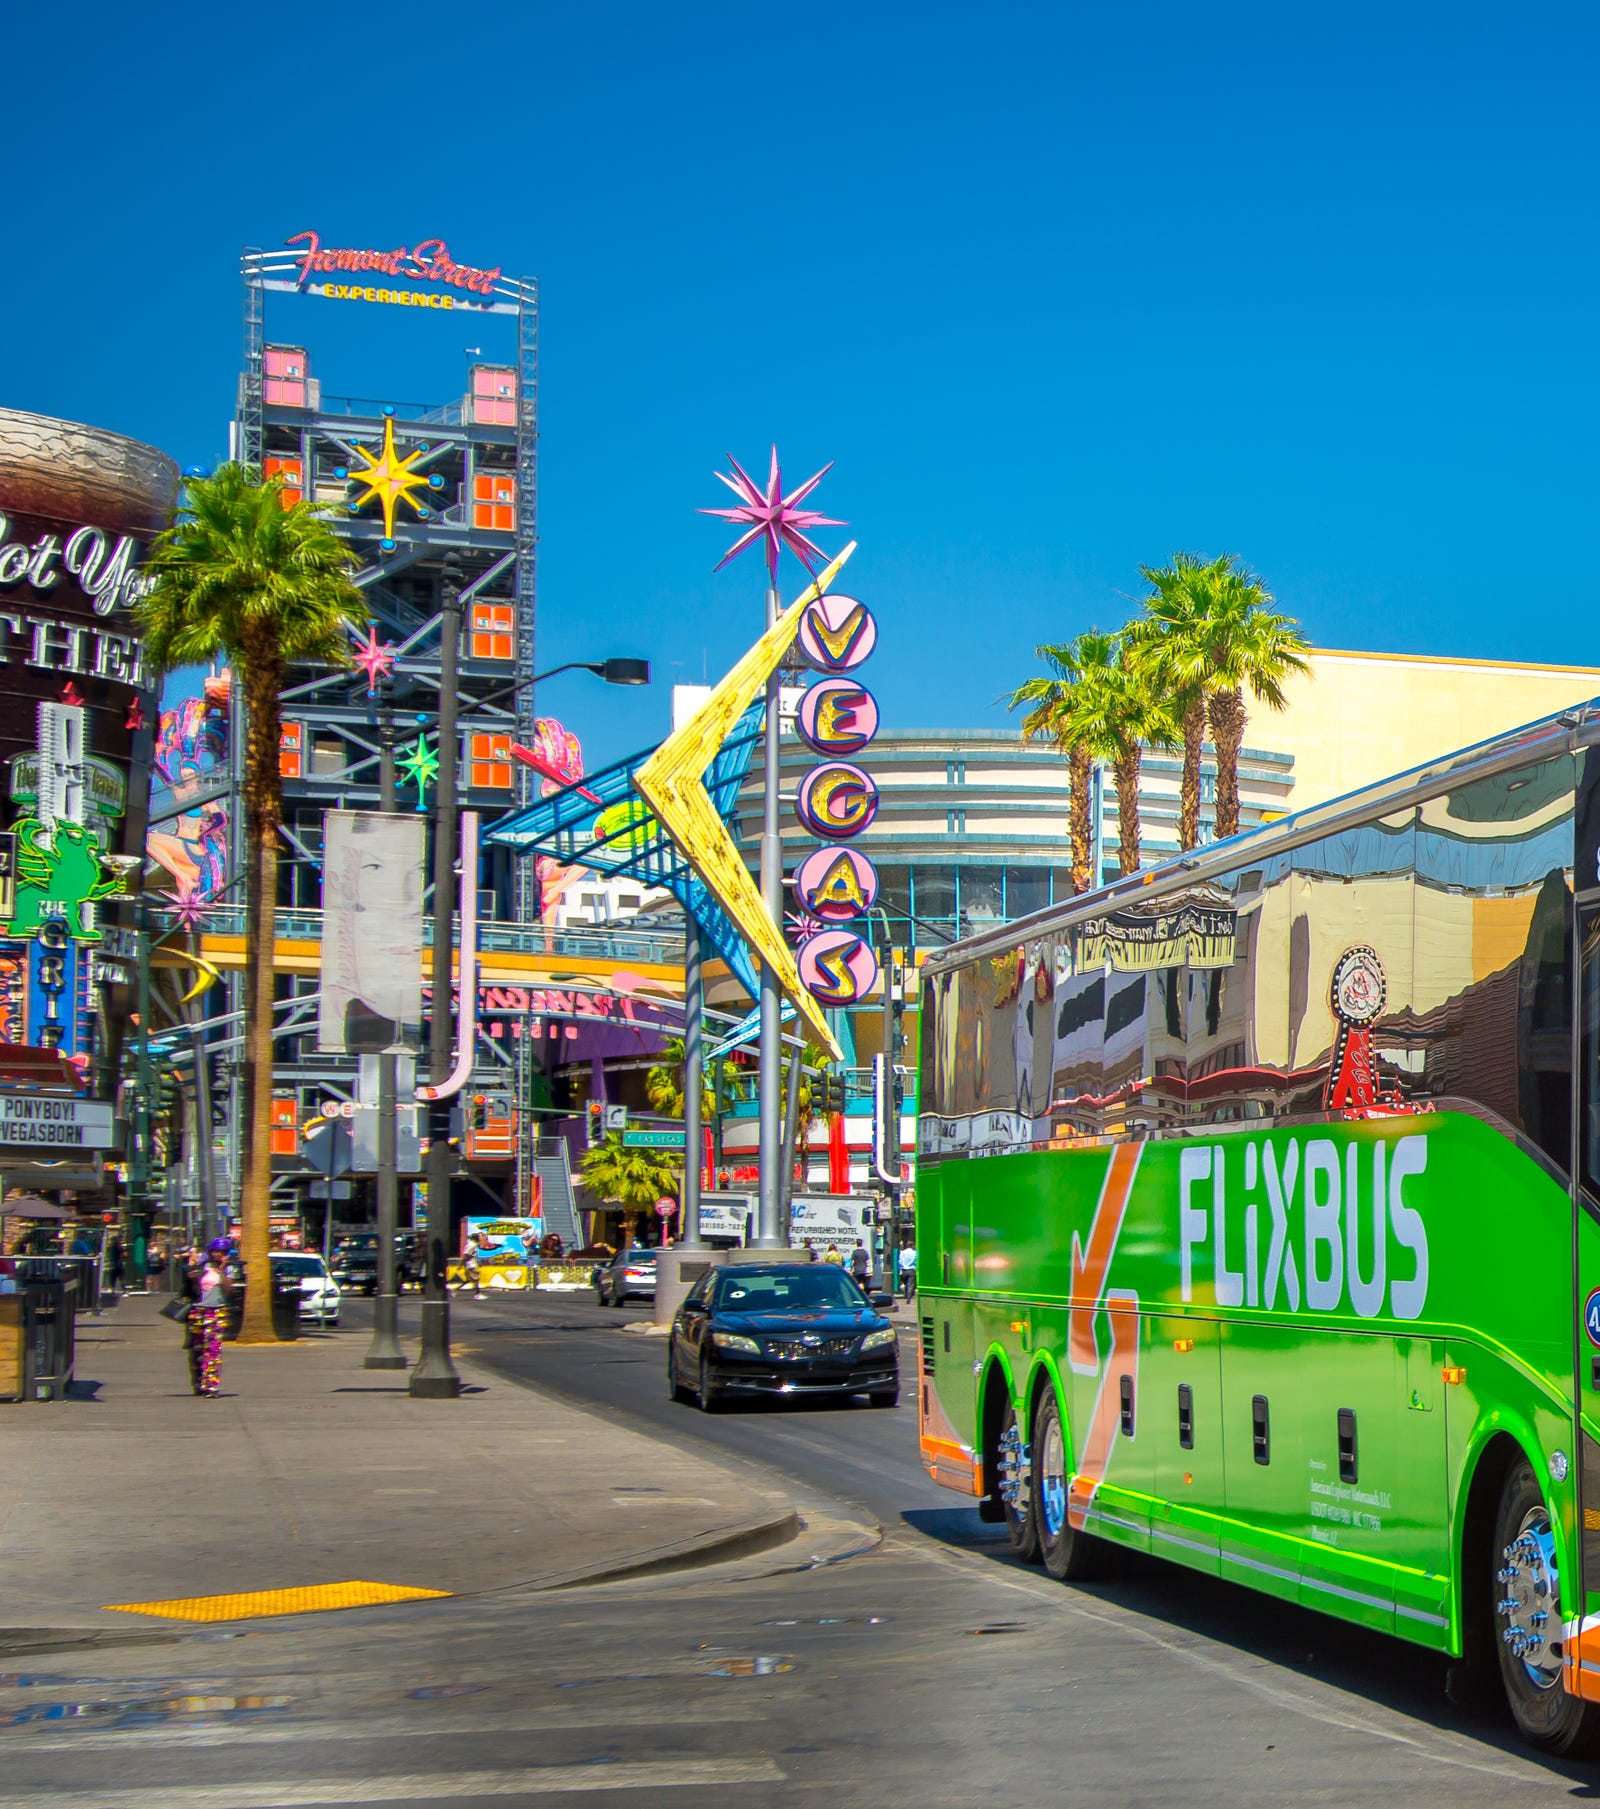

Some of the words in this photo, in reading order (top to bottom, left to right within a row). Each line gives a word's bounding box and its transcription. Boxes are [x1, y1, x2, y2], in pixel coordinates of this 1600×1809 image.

[285, 230, 406, 287] Fremont
[403, 238, 501, 295] Street
[323, 282, 453, 310] EXPERIENCE
[806, 602, 879, 998] VEGAS
[4, 1100, 76, 1121] PONYBOY!
